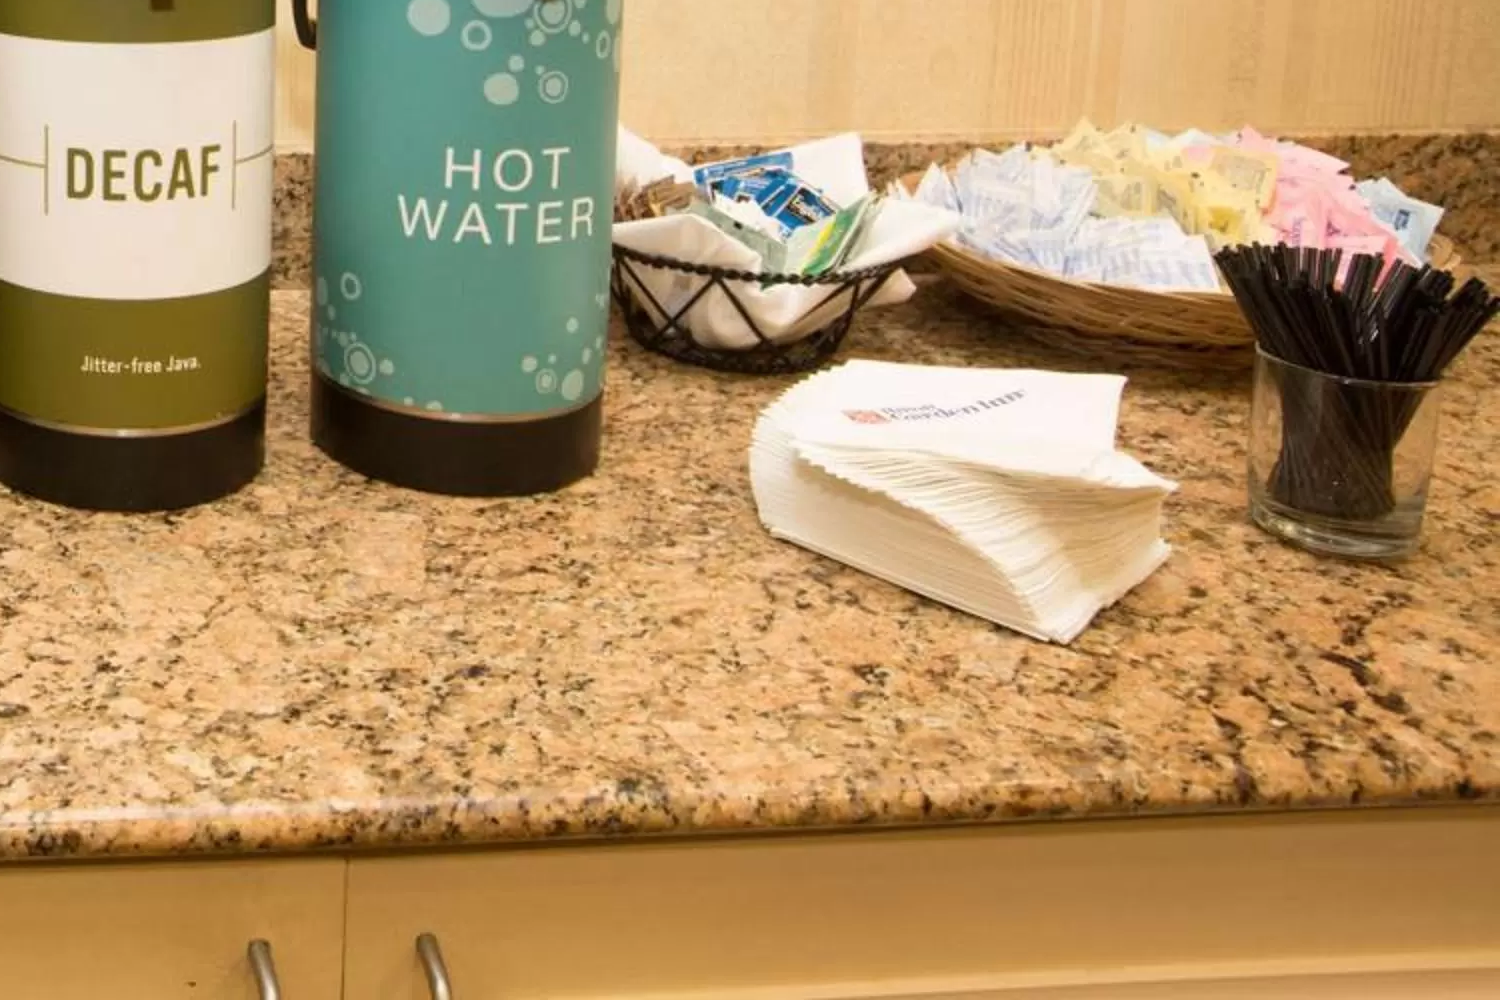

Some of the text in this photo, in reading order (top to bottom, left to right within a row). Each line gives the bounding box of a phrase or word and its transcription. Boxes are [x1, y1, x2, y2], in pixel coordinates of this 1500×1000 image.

[65, 143, 222, 202] DECAF
[443, 146, 571, 192] HOT
[397, 193, 595, 246] WATER
[80, 354, 163, 374] Jitter-free
